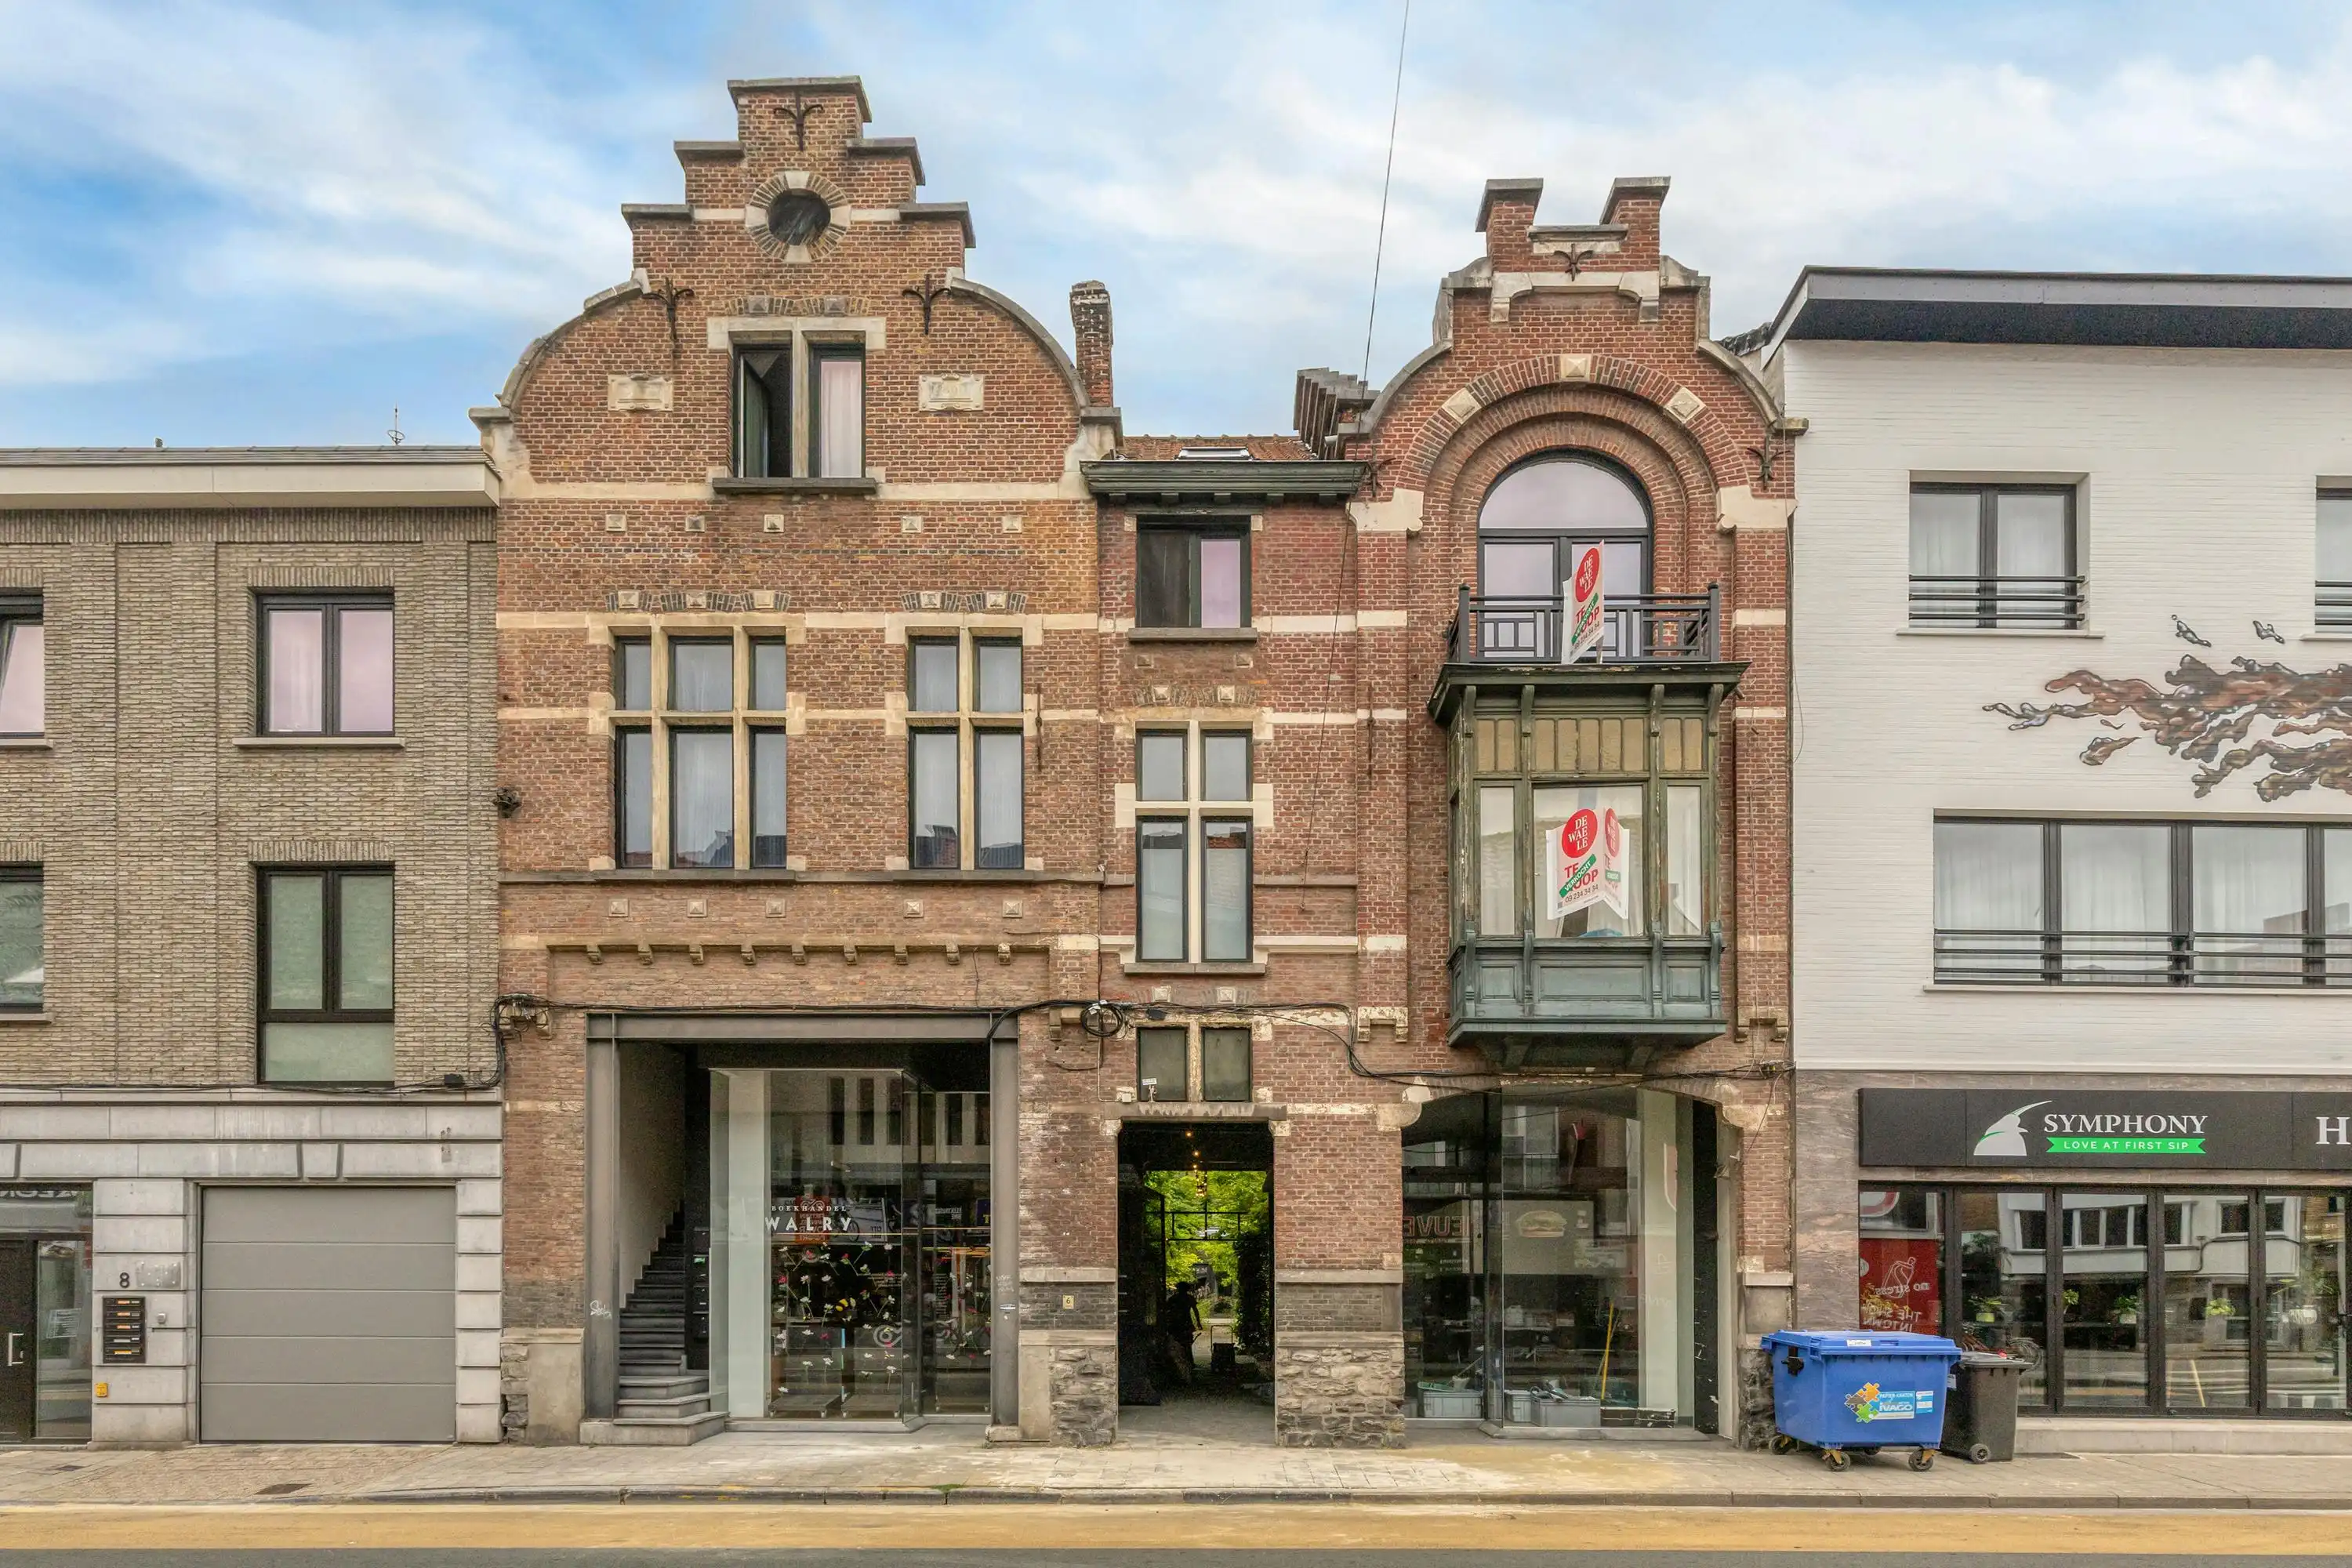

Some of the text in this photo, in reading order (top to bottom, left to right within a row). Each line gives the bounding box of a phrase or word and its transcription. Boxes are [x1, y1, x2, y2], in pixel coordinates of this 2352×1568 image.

[1584, 554, 1593, 569] DE
[1579, 566, 1593, 587] WAE
[1584, 579, 1593, 593] LE
[1574, 602, 1595, 637] VERKOCHT
[1576, 604, 1586, 623] TE
[1575, 815, 1588, 830] DE
[1568, 826, 1588, 843] WAE
[1577, 837, 1588, 851] LE
[1564, 862, 1579, 878] TE
[1564, 860, 1592, 891] VERKOCHT
[1565, 894, 1573, 902] 09
[1573, 890, 1583, 899] 234
[1592, 884, 1599, 892] 34
[2044, 1114, 2208, 1134] SYMPHONY
[2315, 1116, 2351, 1145] H
[2063, 1141, 2097, 1149] LOVE
[2103, 1141, 2118, 1149] AT
[764, 1217, 851, 1232] WALRY
[119, 1272, 130, 1288] 8
